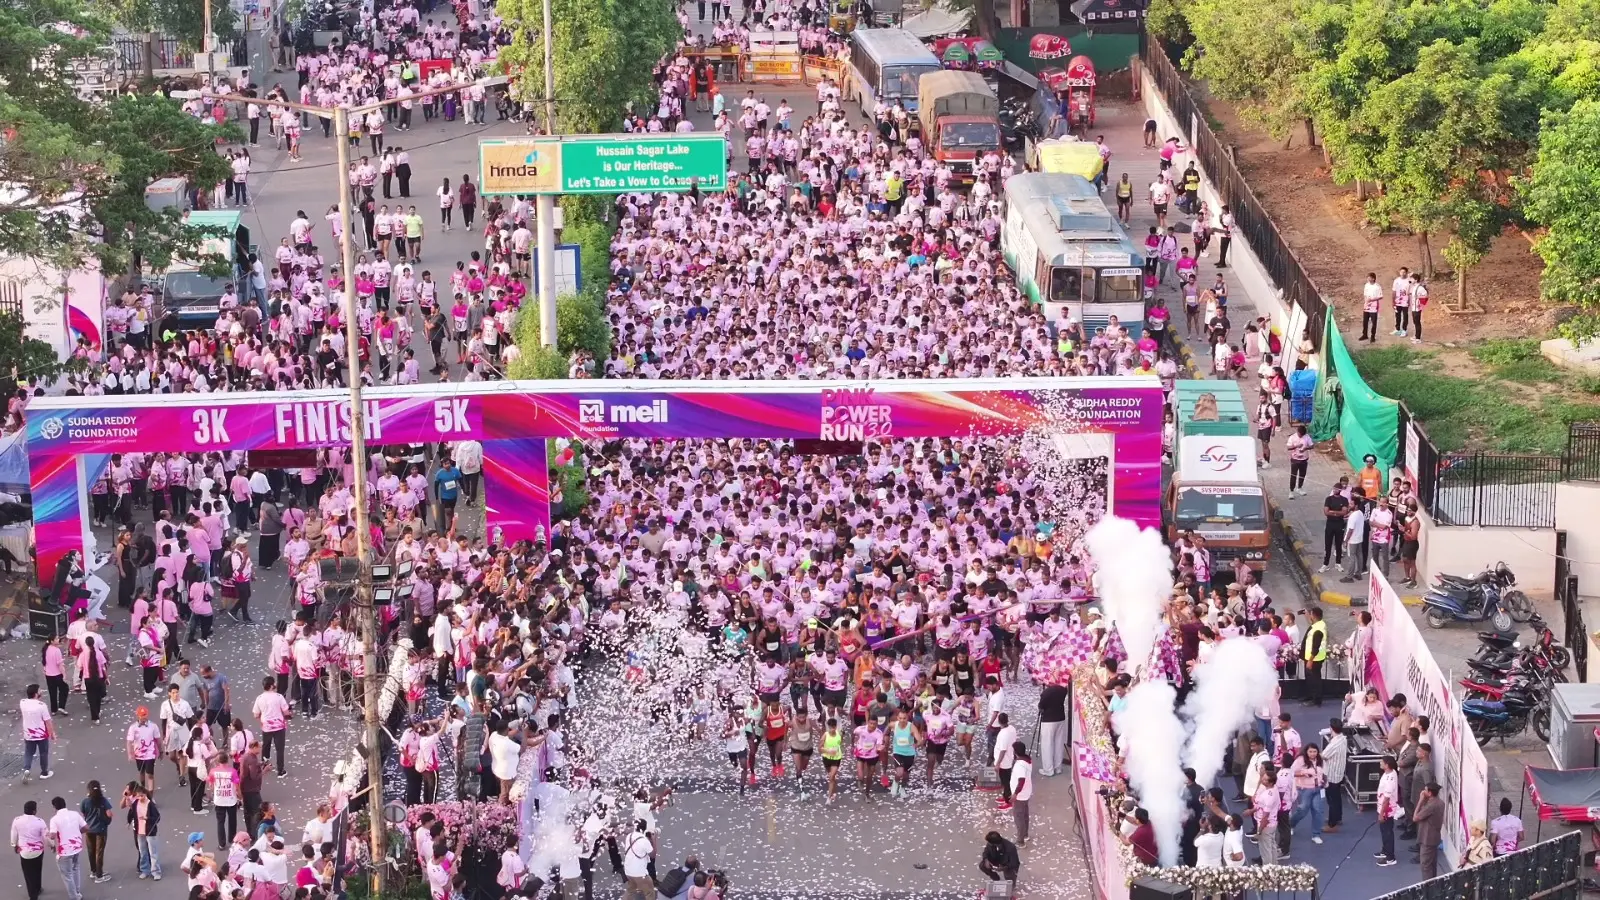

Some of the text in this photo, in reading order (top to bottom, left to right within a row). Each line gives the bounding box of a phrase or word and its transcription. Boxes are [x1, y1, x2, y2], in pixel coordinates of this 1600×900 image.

[596, 144, 690, 157] Hussain Sagar Lake
[490, 165, 537, 177] hmda
[603, 160, 683, 172] is Our Heritage...
[568, 177, 591, 188] Let's
[593, 176, 617, 187] Take
[619, 178, 625, 187] a
[627, 176, 648, 186] Vow
[650, 176, 660, 186] to
[821, 388, 875, 406] PINK
[1109, 398, 1142, 407] REDDY
[434, 399, 471, 433] 5K
[610, 399, 668, 423] meil
[821, 405, 892, 423] POWER
[68, 416, 137, 426] SUDHA REDDY
[192, 408, 230, 444] 3K
[275, 400, 382, 443] FINISH
[69, 428, 138, 438] FOUNDATION
[820, 424, 864, 441] RUN
[1200, 454, 1238, 462] SVS
